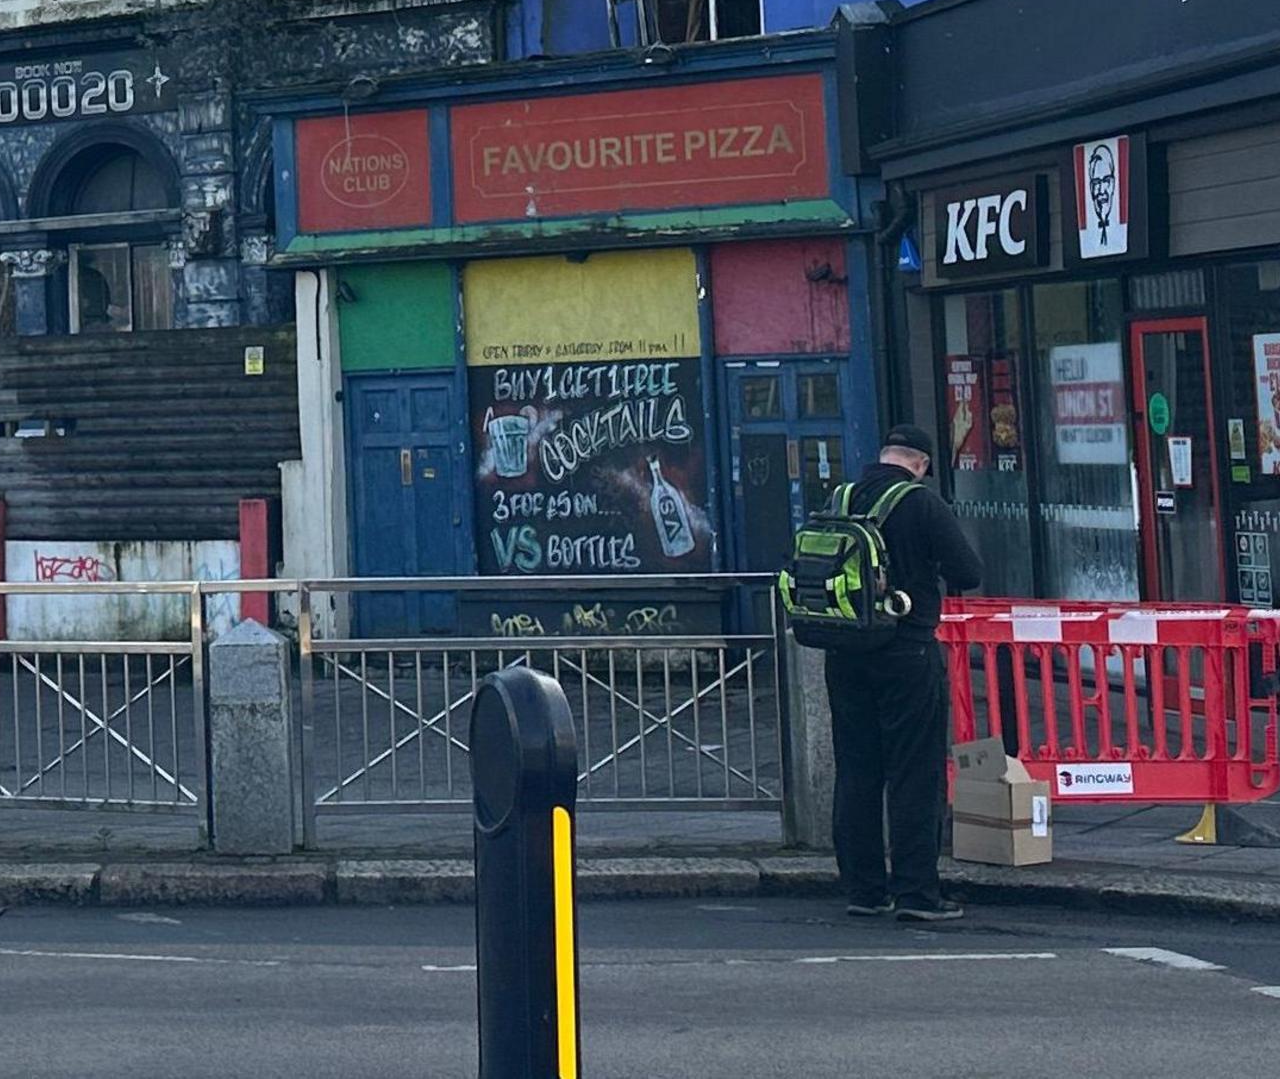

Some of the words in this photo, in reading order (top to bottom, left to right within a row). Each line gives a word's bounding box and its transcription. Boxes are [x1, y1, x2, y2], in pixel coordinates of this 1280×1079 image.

[15, 64, 50, 79] BOOK
[328, 151, 404, 175] NATIONS
[482, 132, 676, 176] FAVOURITE
[684, 124, 794, 159] PIZZA
[343, 174, 391, 194] CLUB
[942, 189, 1027, 264] KFC
[540, 394, 691, 482] COCKTAILS
[490, 524, 543, 571] VS
[547, 533, 641, 569] BOTTLES
[1075, 773, 1131, 784] RINGWAY
